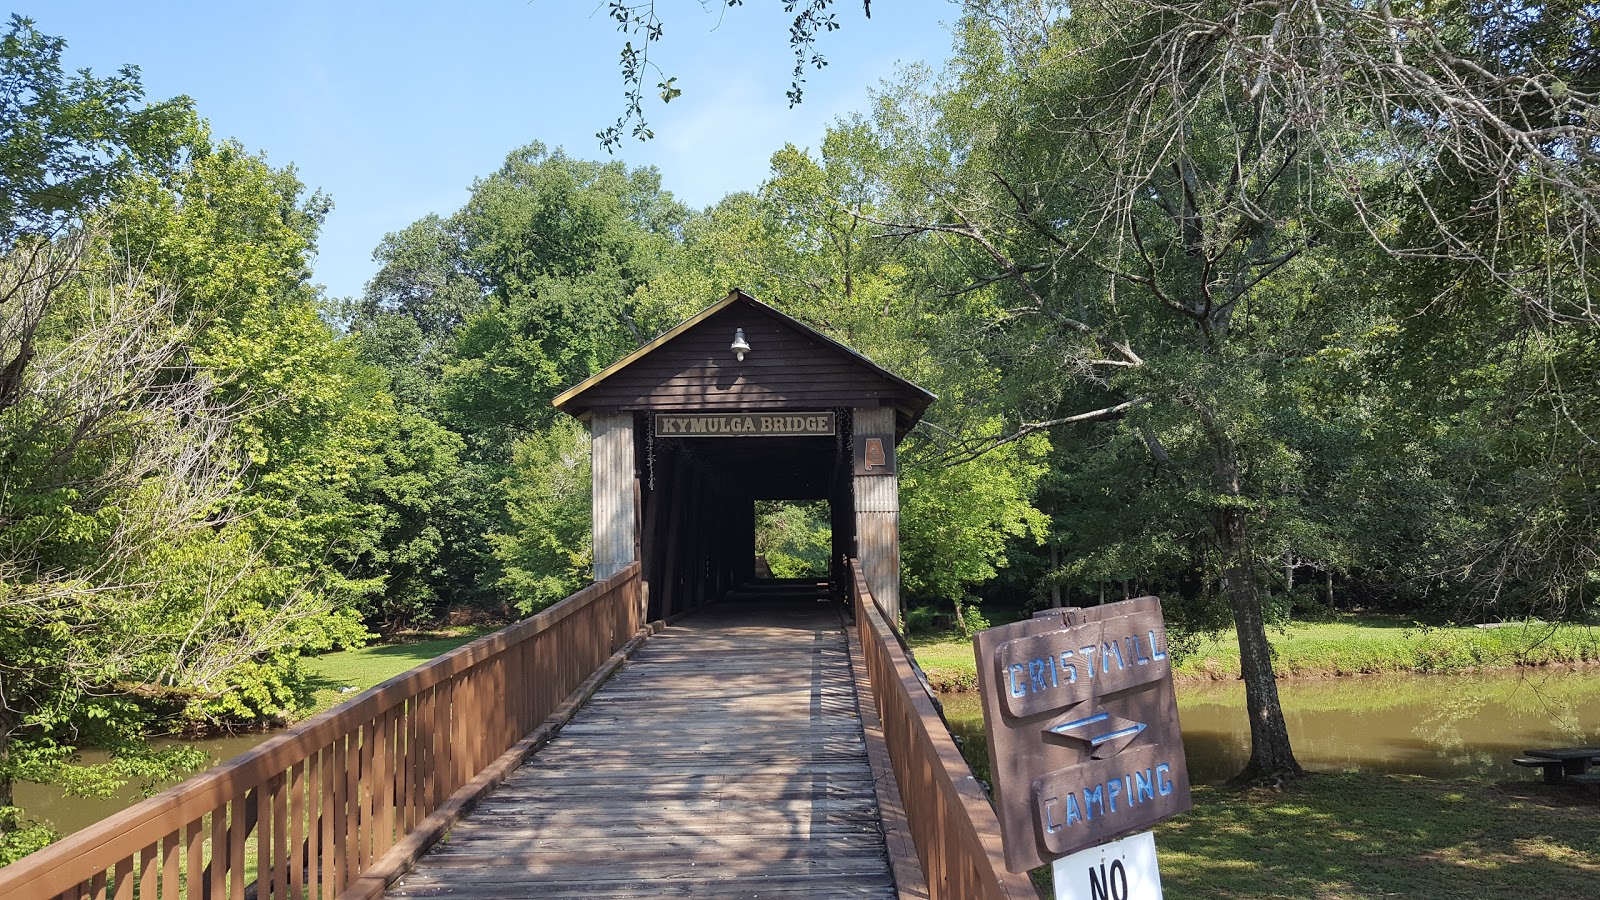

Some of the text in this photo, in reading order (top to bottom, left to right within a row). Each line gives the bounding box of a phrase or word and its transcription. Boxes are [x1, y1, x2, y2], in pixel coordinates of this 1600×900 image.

[663, 416, 829, 433] KYMULGA BRIDGE
[1045, 762, 1173, 834] CAMPING
[1089, 859, 1128, 900] NO
